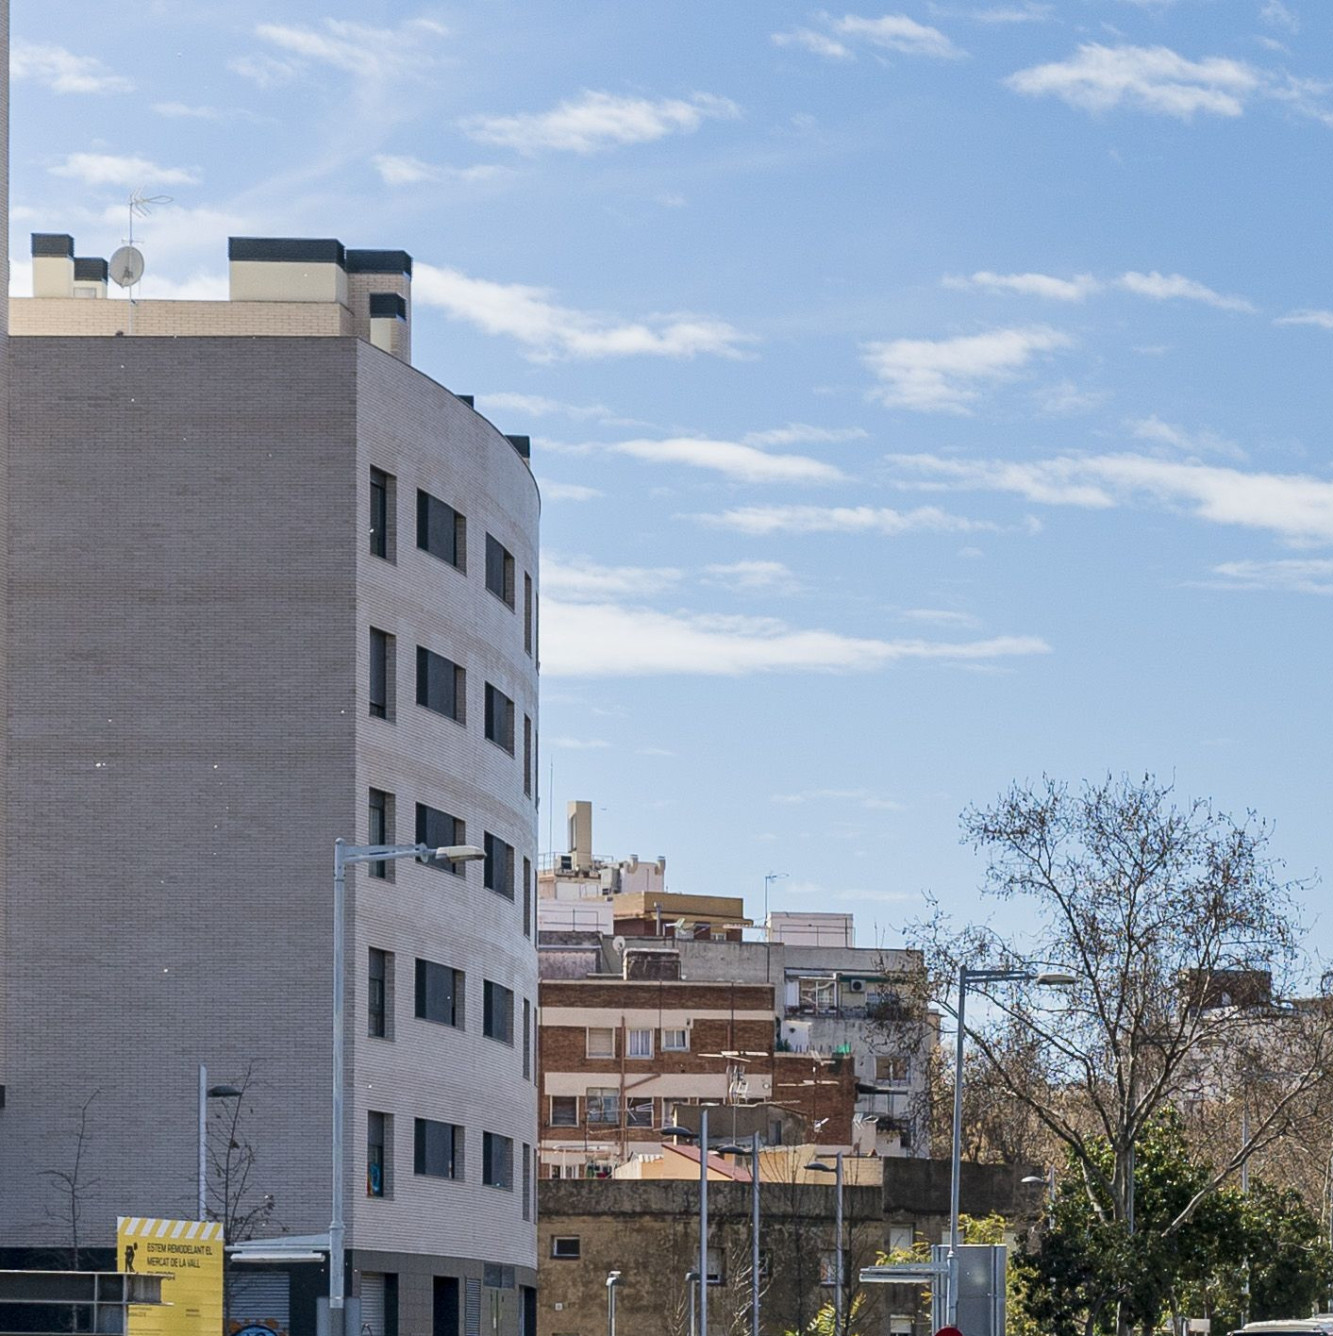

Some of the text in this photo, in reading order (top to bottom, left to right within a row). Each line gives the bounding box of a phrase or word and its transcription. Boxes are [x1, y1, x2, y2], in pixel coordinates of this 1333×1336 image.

[205, 1245, 213, 1255] EL
[147, 1256, 169, 1266] MERCAT
[170, 1257, 178, 1267] DE
[178, 1258, 187, 1267] LA
